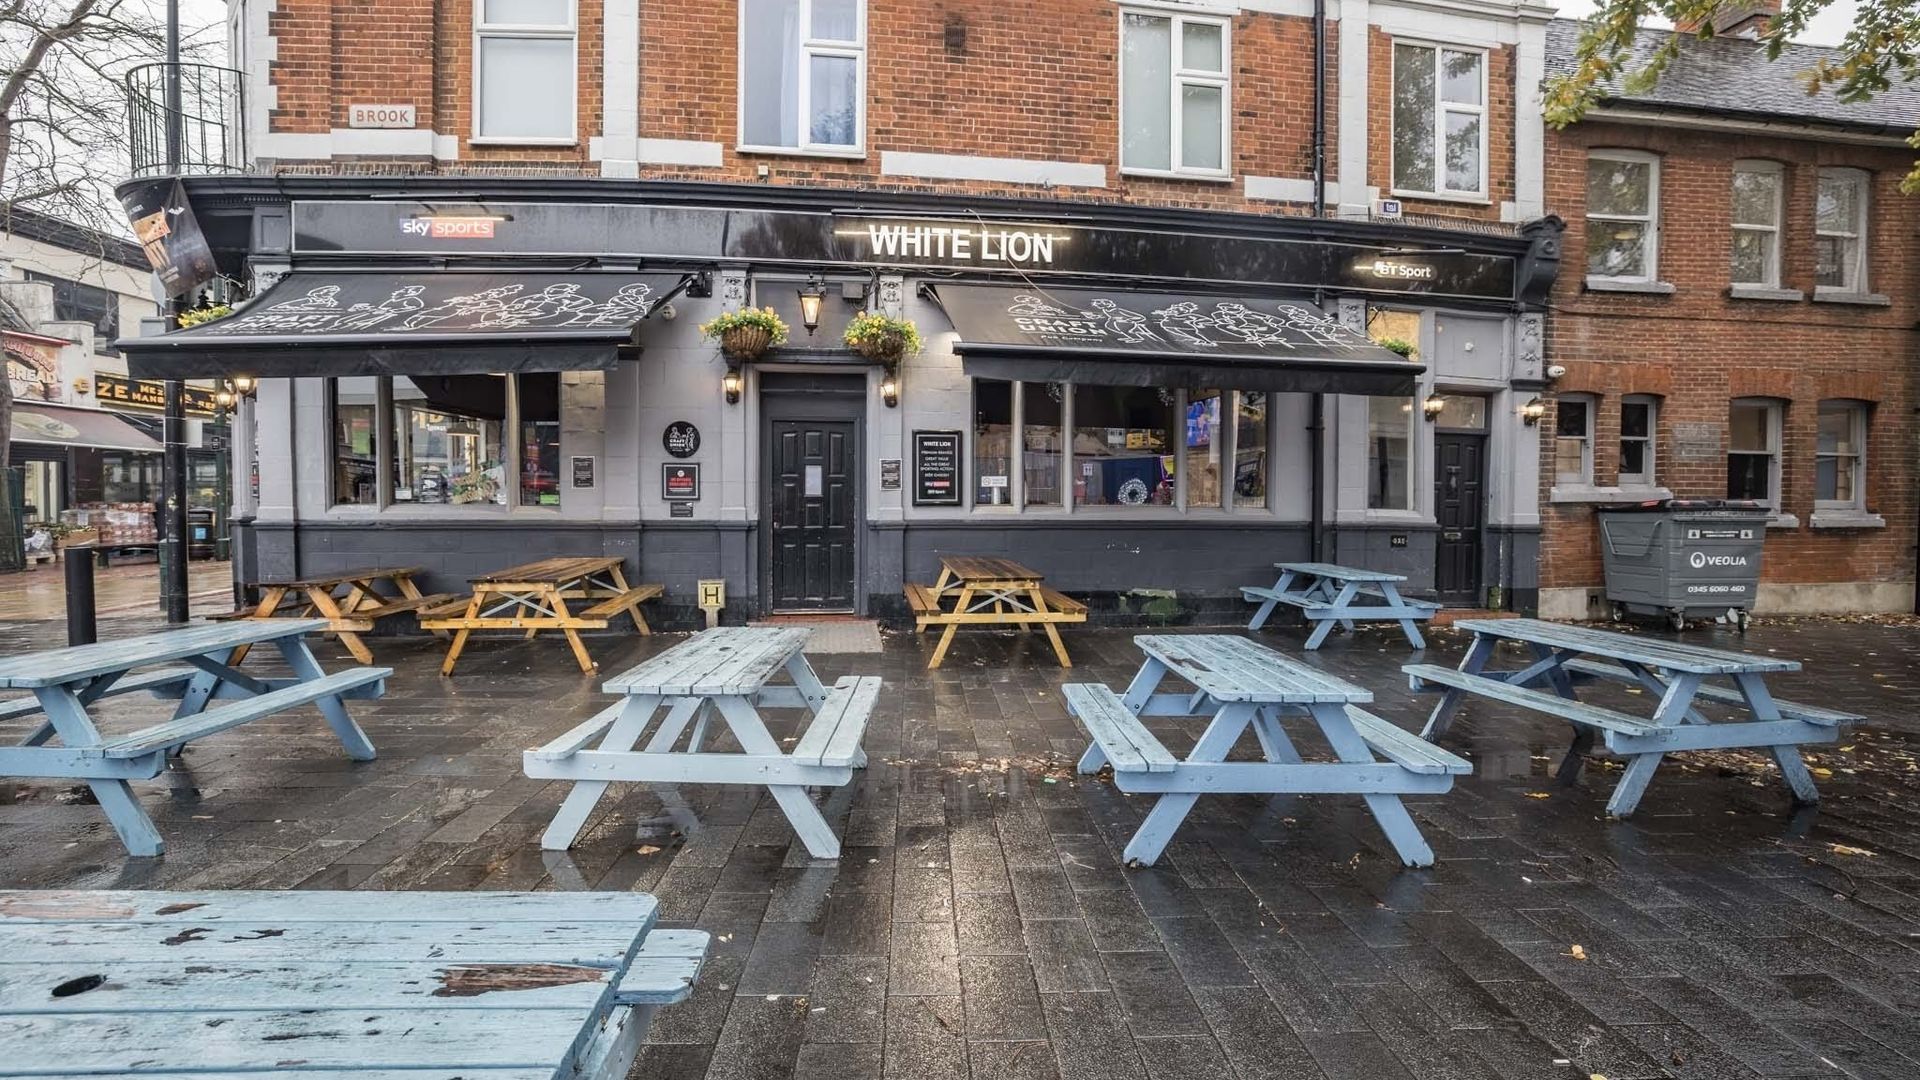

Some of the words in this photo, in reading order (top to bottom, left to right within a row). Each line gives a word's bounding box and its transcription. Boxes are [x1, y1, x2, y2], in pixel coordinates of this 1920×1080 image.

[356, 110, 408, 122] BROOK
[403, 220, 430, 236] sky
[435, 221, 490, 236] sports
[869, 225, 971, 260] WHITE
[981, 230, 1053, 263] LION
[1380, 264, 1398, 276] BT
[1399, 265, 1432, 279] Sport
[1014, 318, 1097, 329] CRAFT
[1018, 324, 1108, 336] UNION
[140, 384, 164, 396] MEZ
[132, 392, 164, 404] MANG
[1707, 556, 1747, 566] VEOLIA
[704, 586, 719, 604] H
